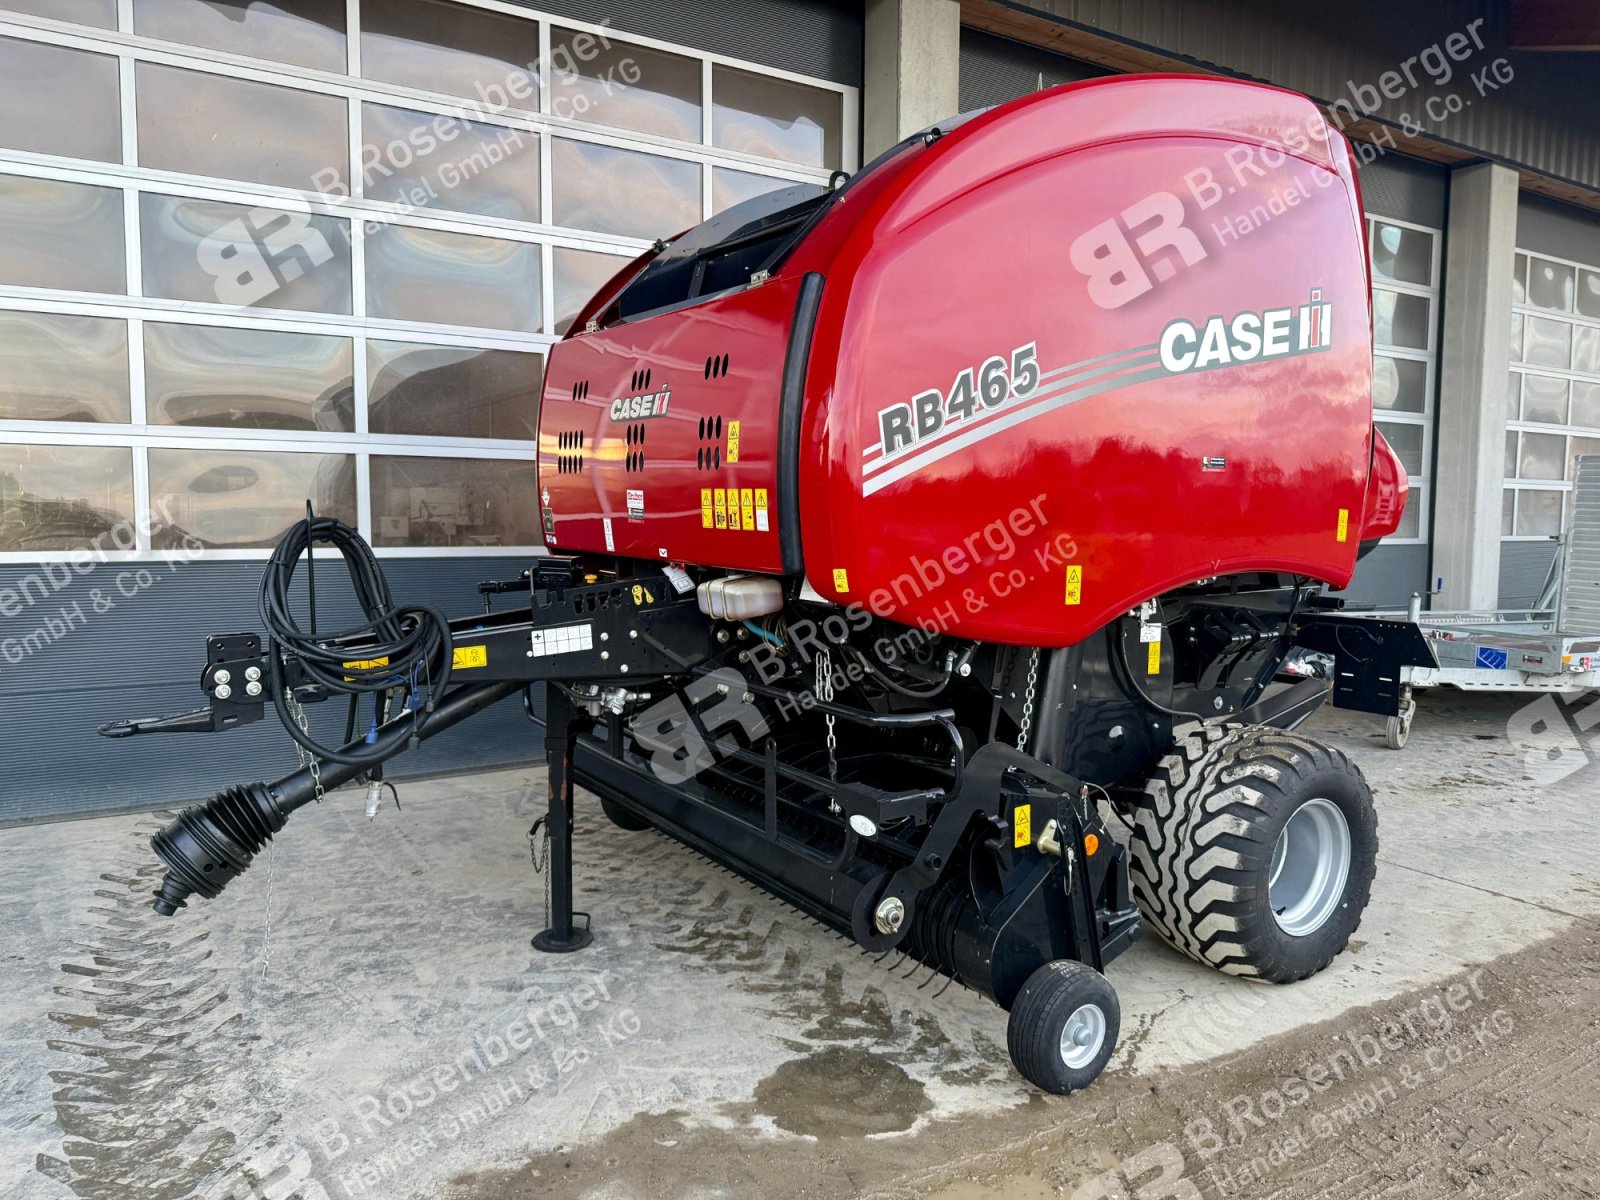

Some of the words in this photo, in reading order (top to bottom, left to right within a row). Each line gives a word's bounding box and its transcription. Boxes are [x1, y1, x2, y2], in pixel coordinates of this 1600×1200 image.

[1159, 308, 1291, 373] CASE
[610, 393, 654, 421] CASE
[879, 341, 1041, 458] RB465
